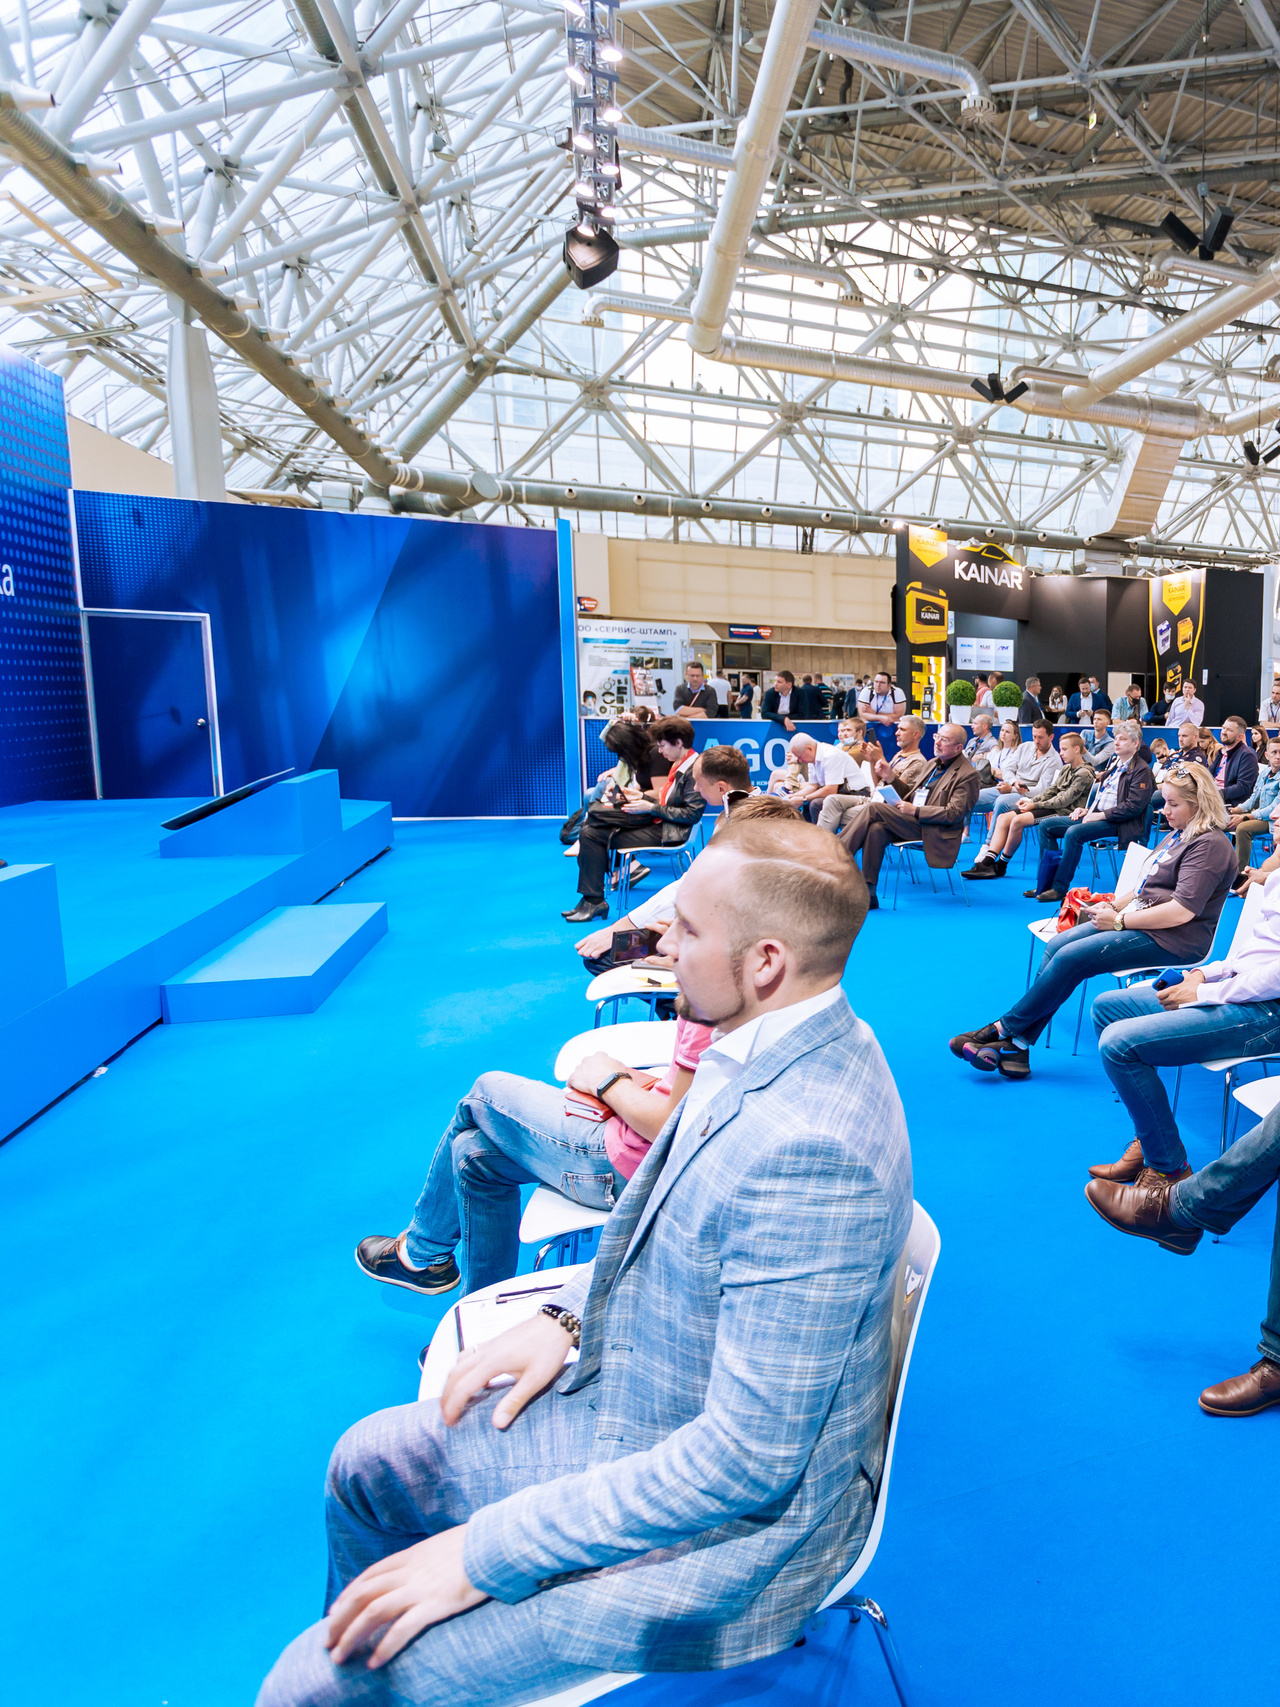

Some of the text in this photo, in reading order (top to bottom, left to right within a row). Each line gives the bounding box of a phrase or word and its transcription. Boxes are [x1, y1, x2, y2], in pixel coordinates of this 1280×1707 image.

[954, 559, 1023, 591] KAINAR
[921, 611, 940, 620] KAINAR
[594, 626, 677, 636] «СЕРВИС-ШТАМП»
